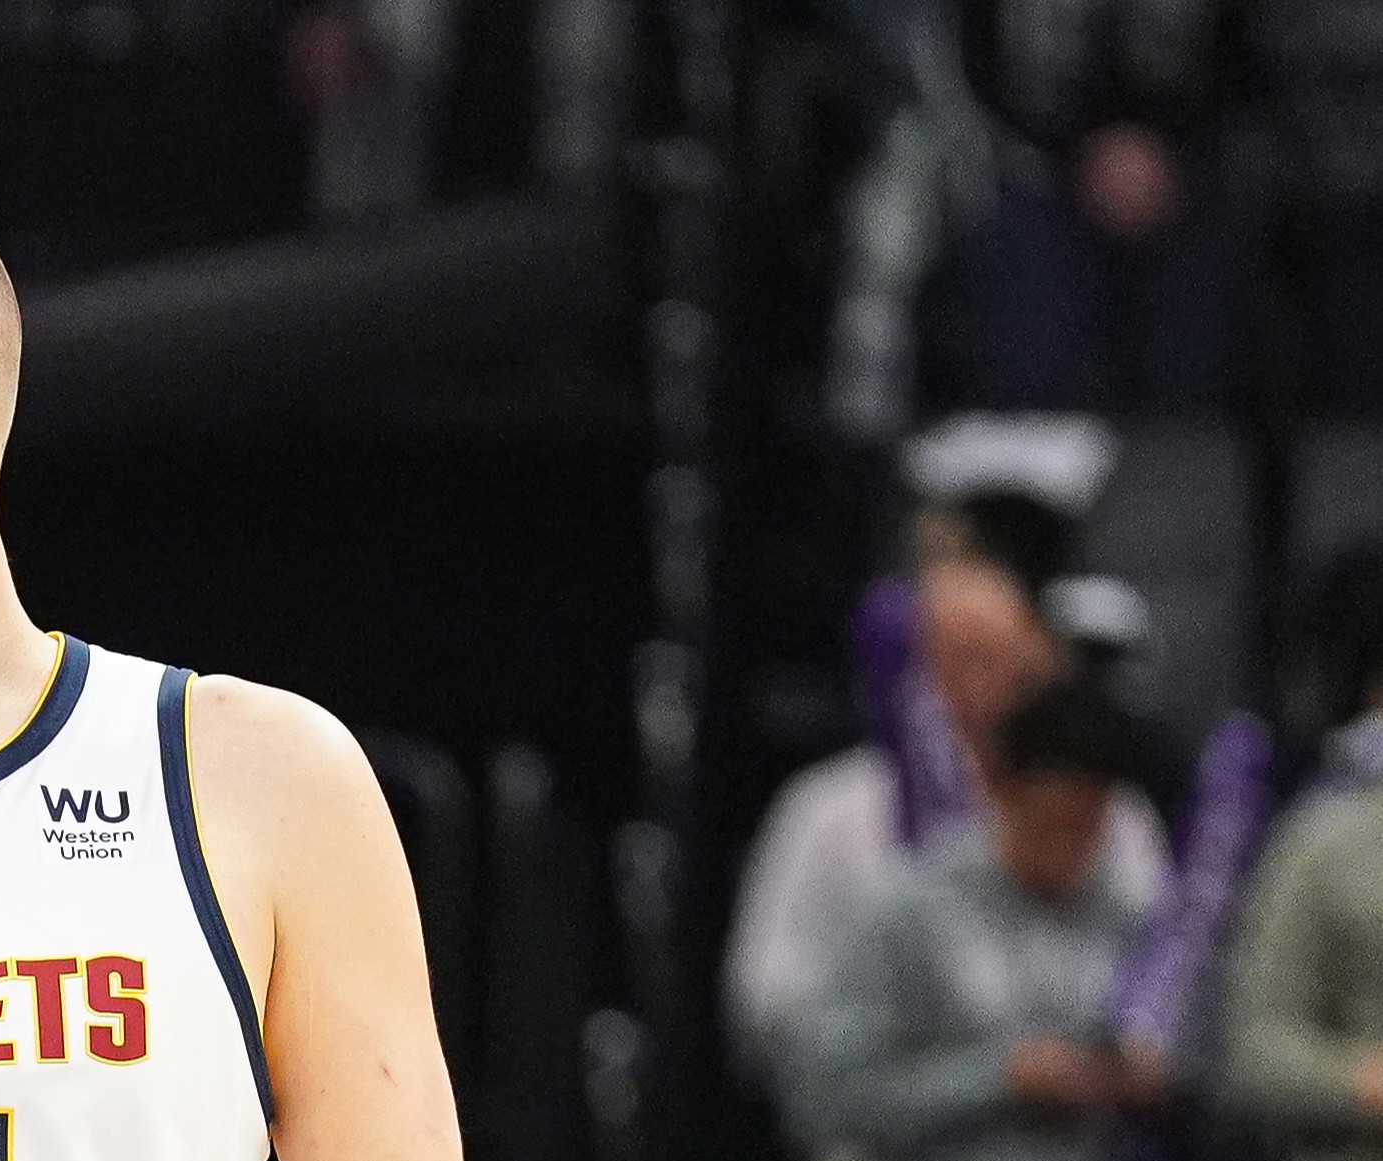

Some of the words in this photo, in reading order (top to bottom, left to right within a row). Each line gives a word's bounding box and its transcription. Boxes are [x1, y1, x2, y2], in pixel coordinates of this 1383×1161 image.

[40, 784, 130, 823] WU
[42, 828, 134, 843] Western
[60, 844, 122, 860] Union
